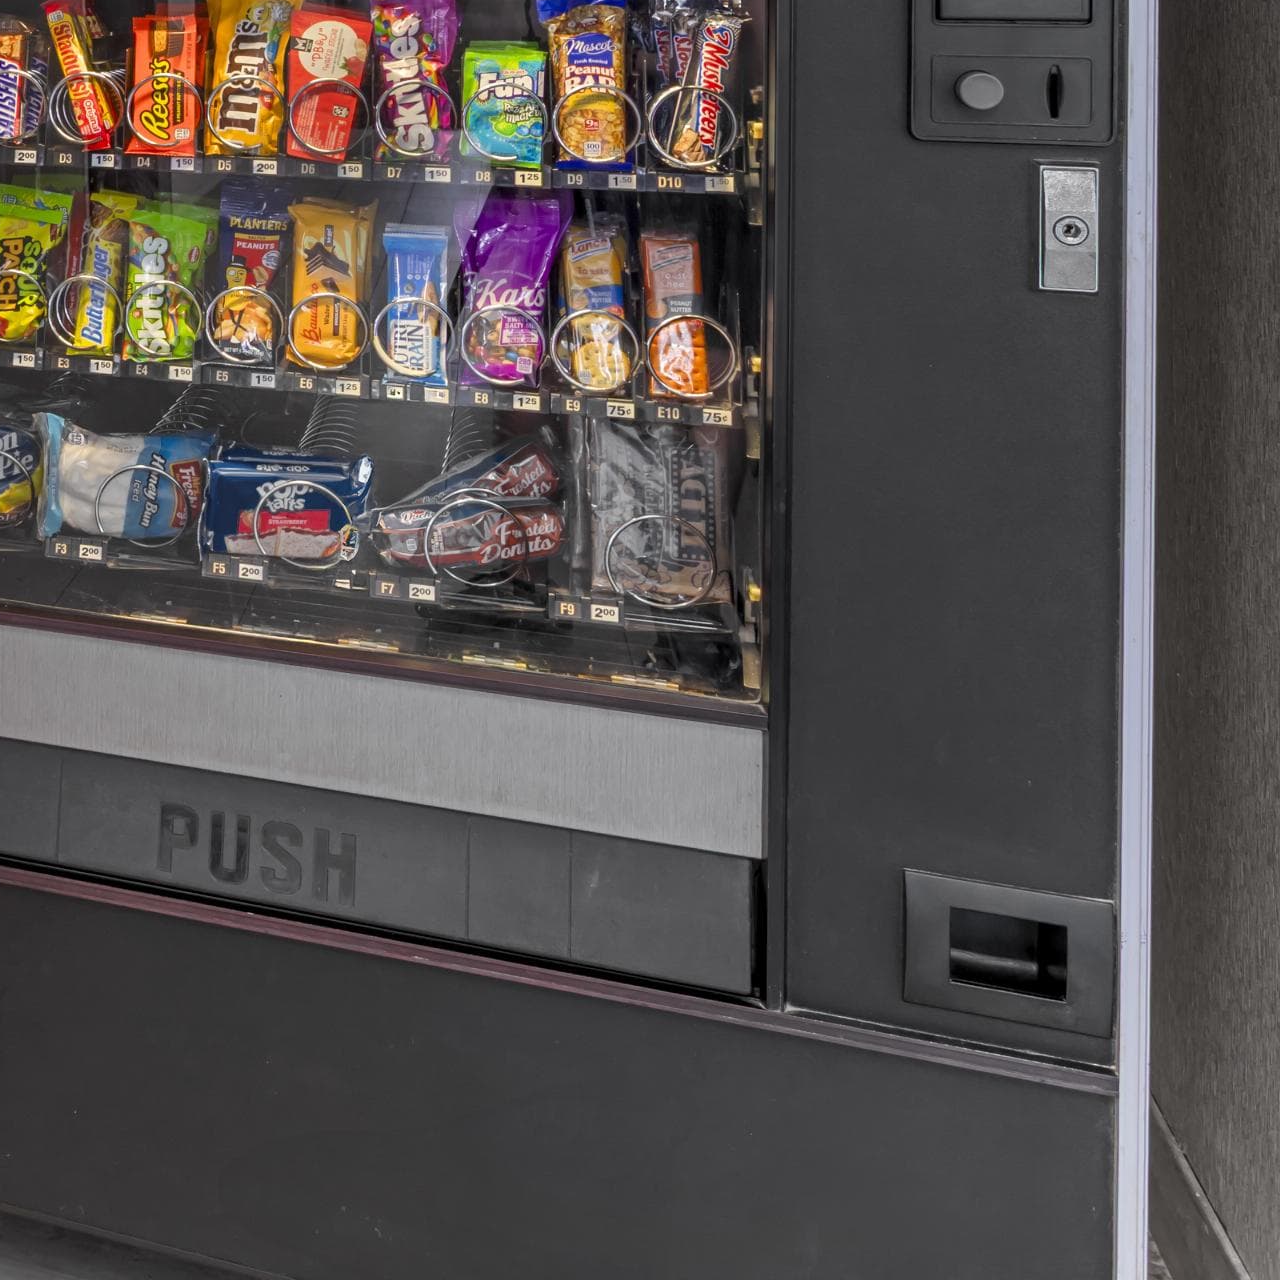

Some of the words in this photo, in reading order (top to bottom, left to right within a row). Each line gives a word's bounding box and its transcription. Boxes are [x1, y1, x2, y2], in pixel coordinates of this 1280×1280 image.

[706, 25, 733, 50] 3
[564, 37, 618, 55] Mascot
[565, 65, 615, 78] Peanut
[564, 77, 616, 96] BAR
[700, 41, 730, 149] Musketeers
[59, 153, 72, 164] D3
[218, 160, 231, 171] D5
[387, 167, 402, 179] D7
[567, 174, 583, 185] D9
[658, 176, 682, 189] D10
[229, 216, 288, 231] PLANTERS
[236, 241, 275, 250] PEANUTS
[17, 240, 41, 305] SOUR
[299, 378, 313, 388] E6
[474, 392, 489, 404] E8
[657, 406, 680, 420] E10
[132, 479, 142, 502] Iced
[141, 501, 158, 527] Bun
[55, 543, 67, 554] F3
[381, 582, 394, 595] F7
[560, 603, 575, 615] F9
[156, 800, 358, 909] PUSH
